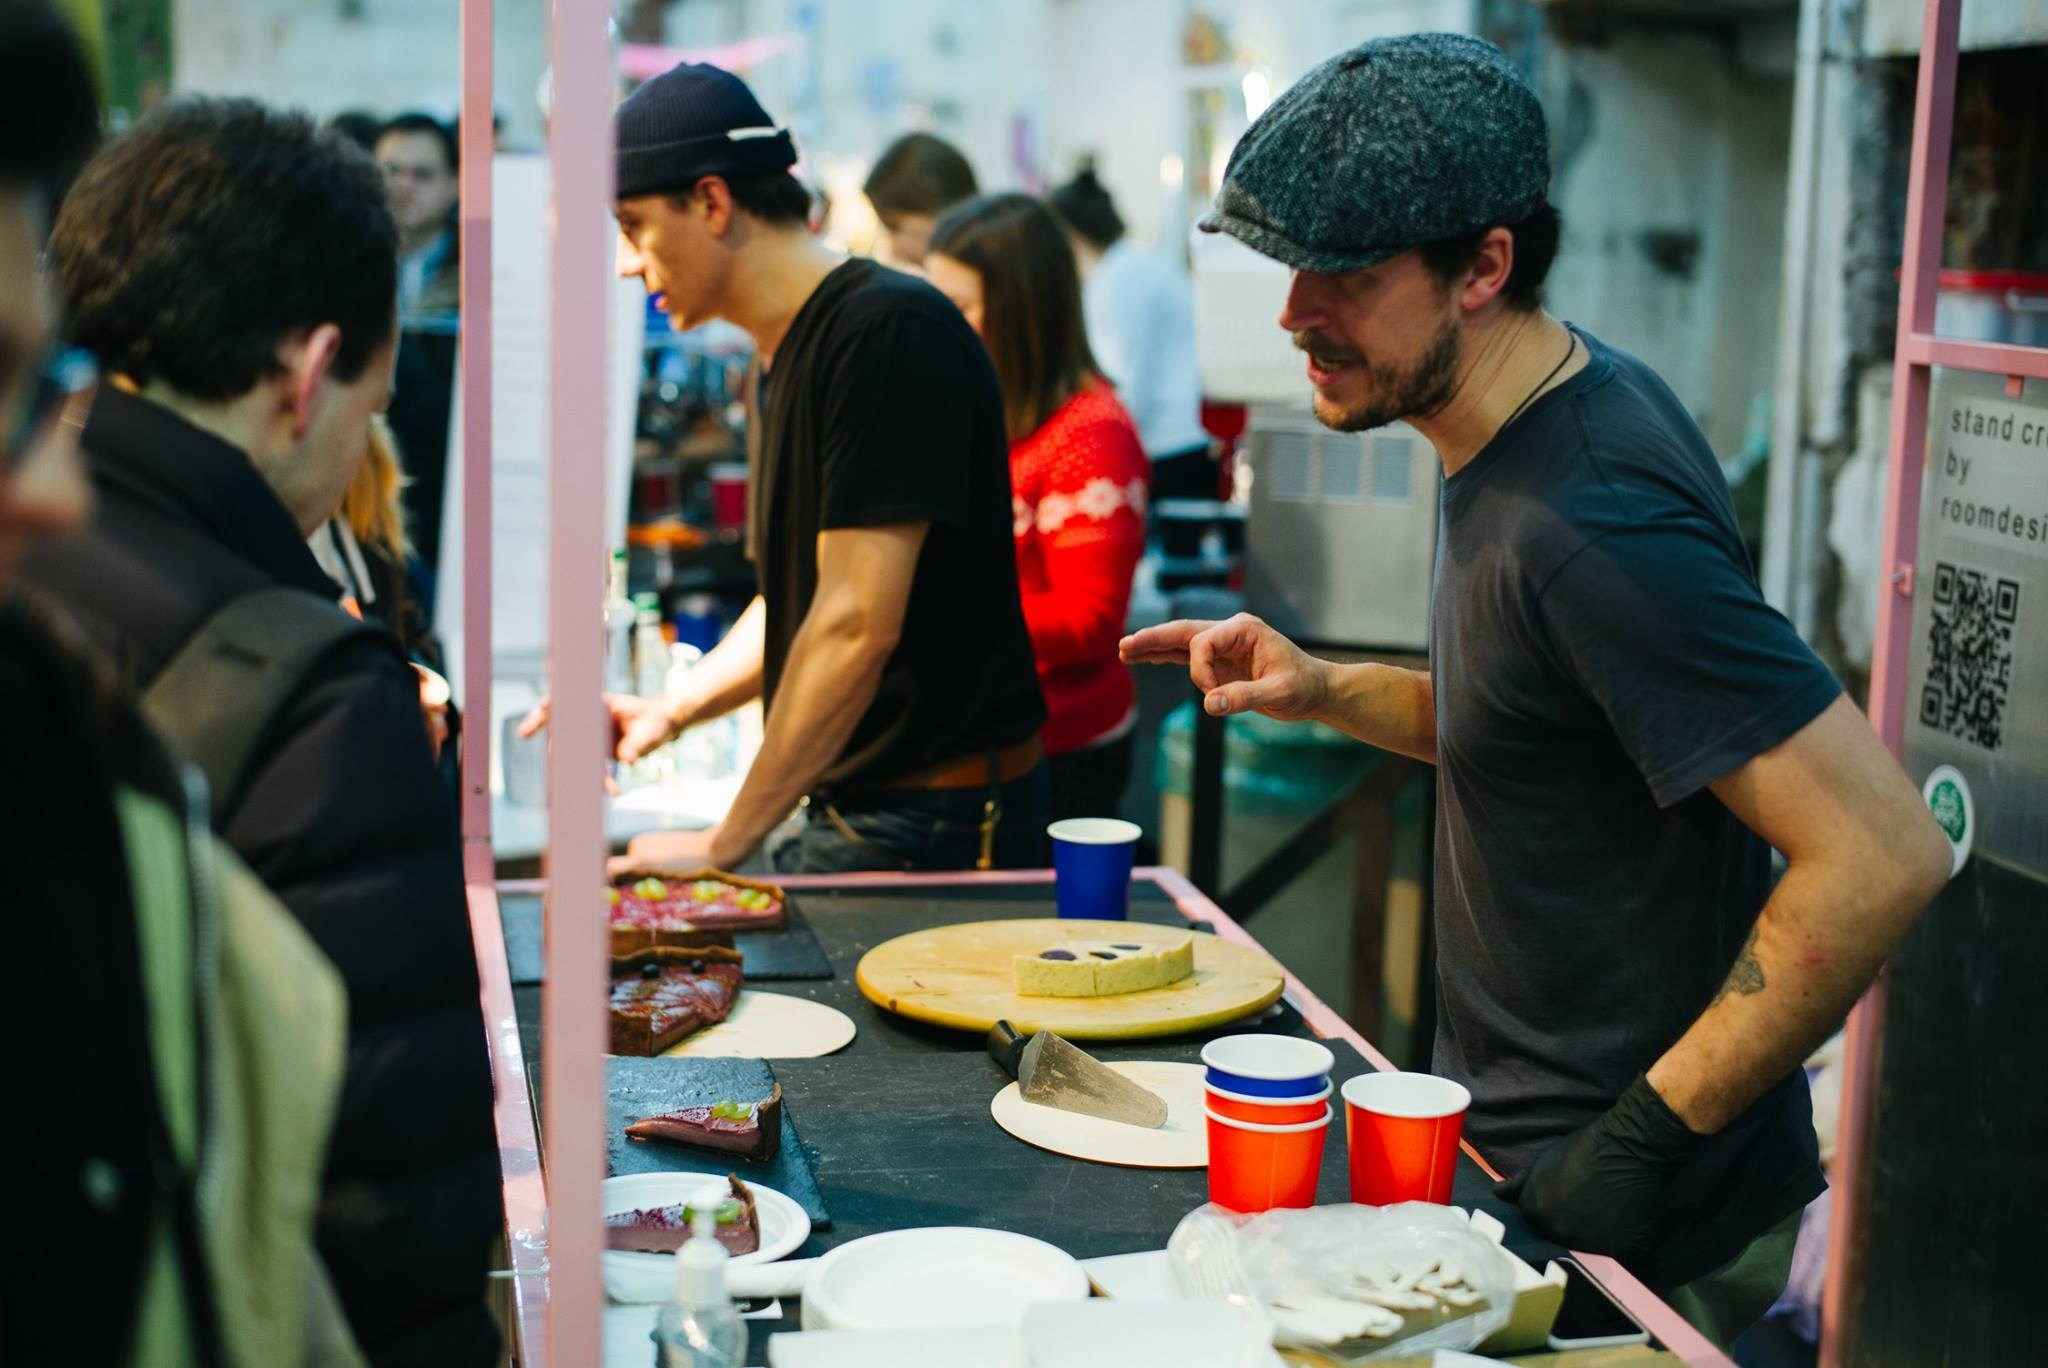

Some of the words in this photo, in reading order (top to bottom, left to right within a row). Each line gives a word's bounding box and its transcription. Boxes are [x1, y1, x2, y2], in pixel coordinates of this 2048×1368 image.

[1951, 405, 2015, 442] stand
[2021, 421, 2048, 447] cr
[1946, 447, 1971, 486] by
[1940, 497, 2048, 543] roomdesi
